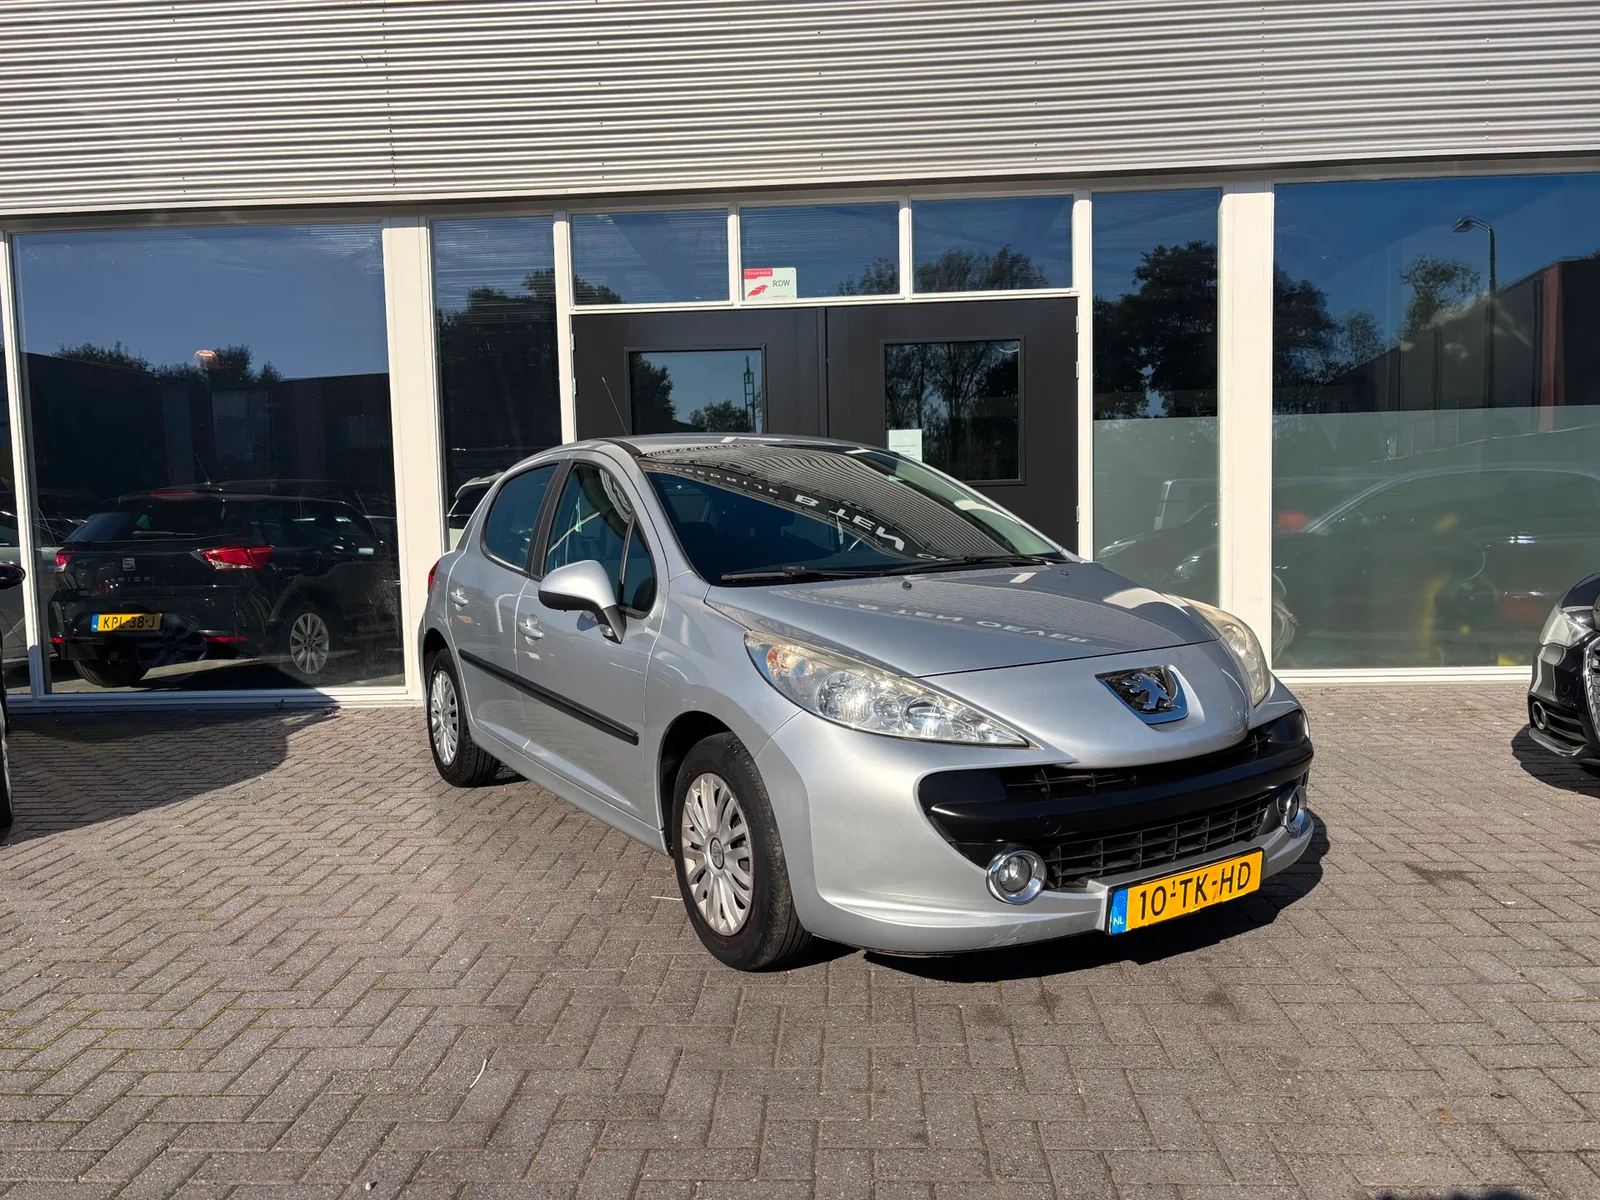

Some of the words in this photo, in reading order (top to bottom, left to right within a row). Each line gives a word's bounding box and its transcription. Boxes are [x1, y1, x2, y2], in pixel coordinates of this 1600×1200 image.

[772, 279, 791, 287] RDW
[103, 616, 155, 629] KPL-38-J
[1113, 915, 1125, 926] NL
